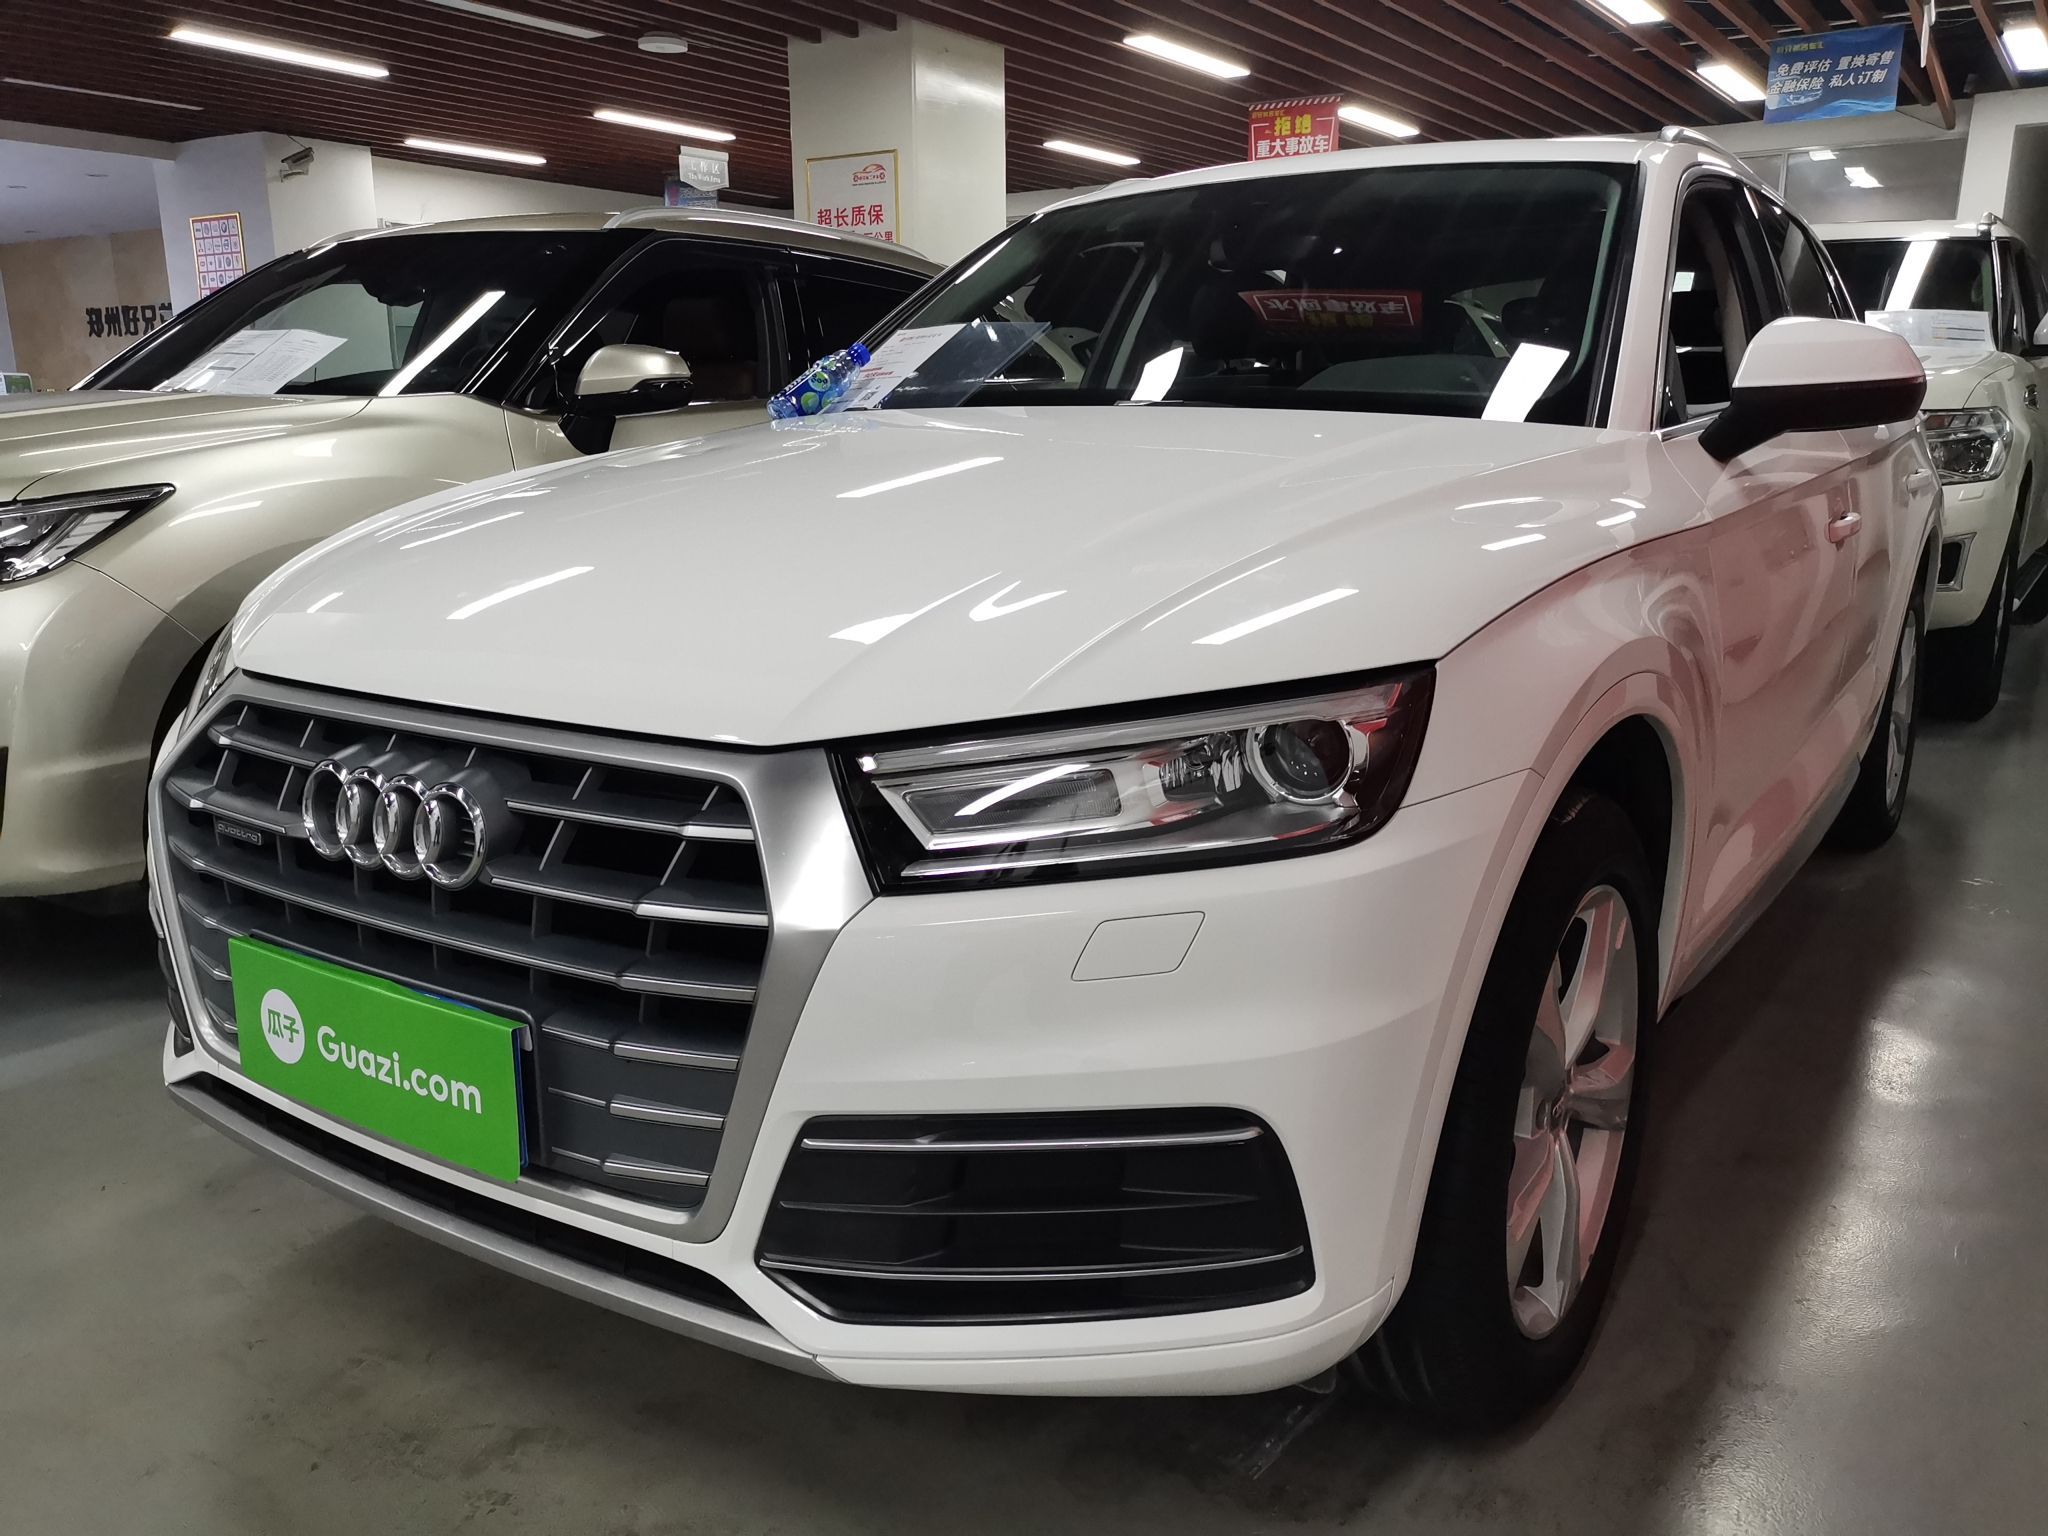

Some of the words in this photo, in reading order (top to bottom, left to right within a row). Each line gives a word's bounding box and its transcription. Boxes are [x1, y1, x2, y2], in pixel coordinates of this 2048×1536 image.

[1776, 58, 1832, 77] 免费评估
[1835, 50, 1895, 70] 置换寄售
[1768, 76, 1825, 95] 金融保险
[1828, 68, 1888, 88] 私人订制
[1274, 114, 1312, 136] 拒绝
[1256, 134, 1329, 159] 重大事故车
[817, 204, 884, 228] 超长质保
[267, 1007, 300, 1045] 瓜子
[317, 1025, 482, 1115] Guazi.com
